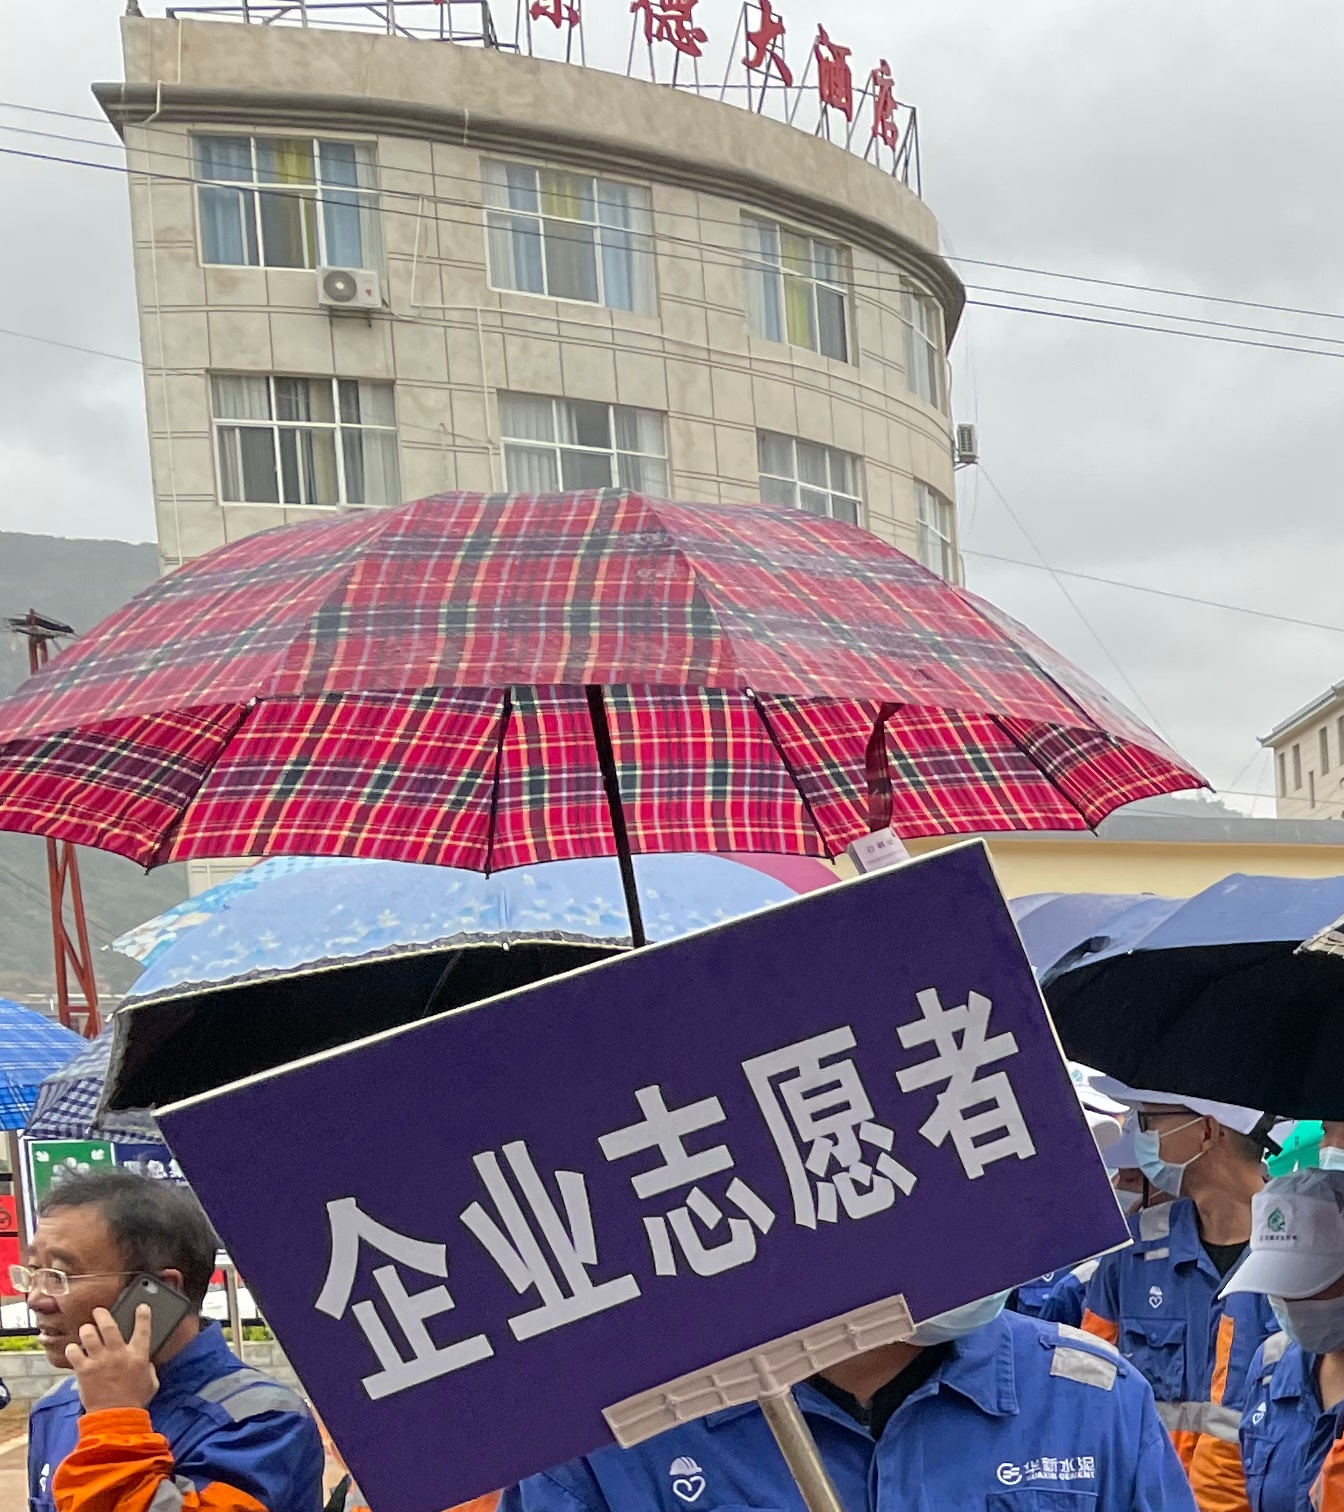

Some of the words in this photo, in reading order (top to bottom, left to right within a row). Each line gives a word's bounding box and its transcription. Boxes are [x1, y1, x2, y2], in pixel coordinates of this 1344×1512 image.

[530, 0, 899, 153] 德大酒店
[314, 987, 1038, 1401] 企业志愿者
